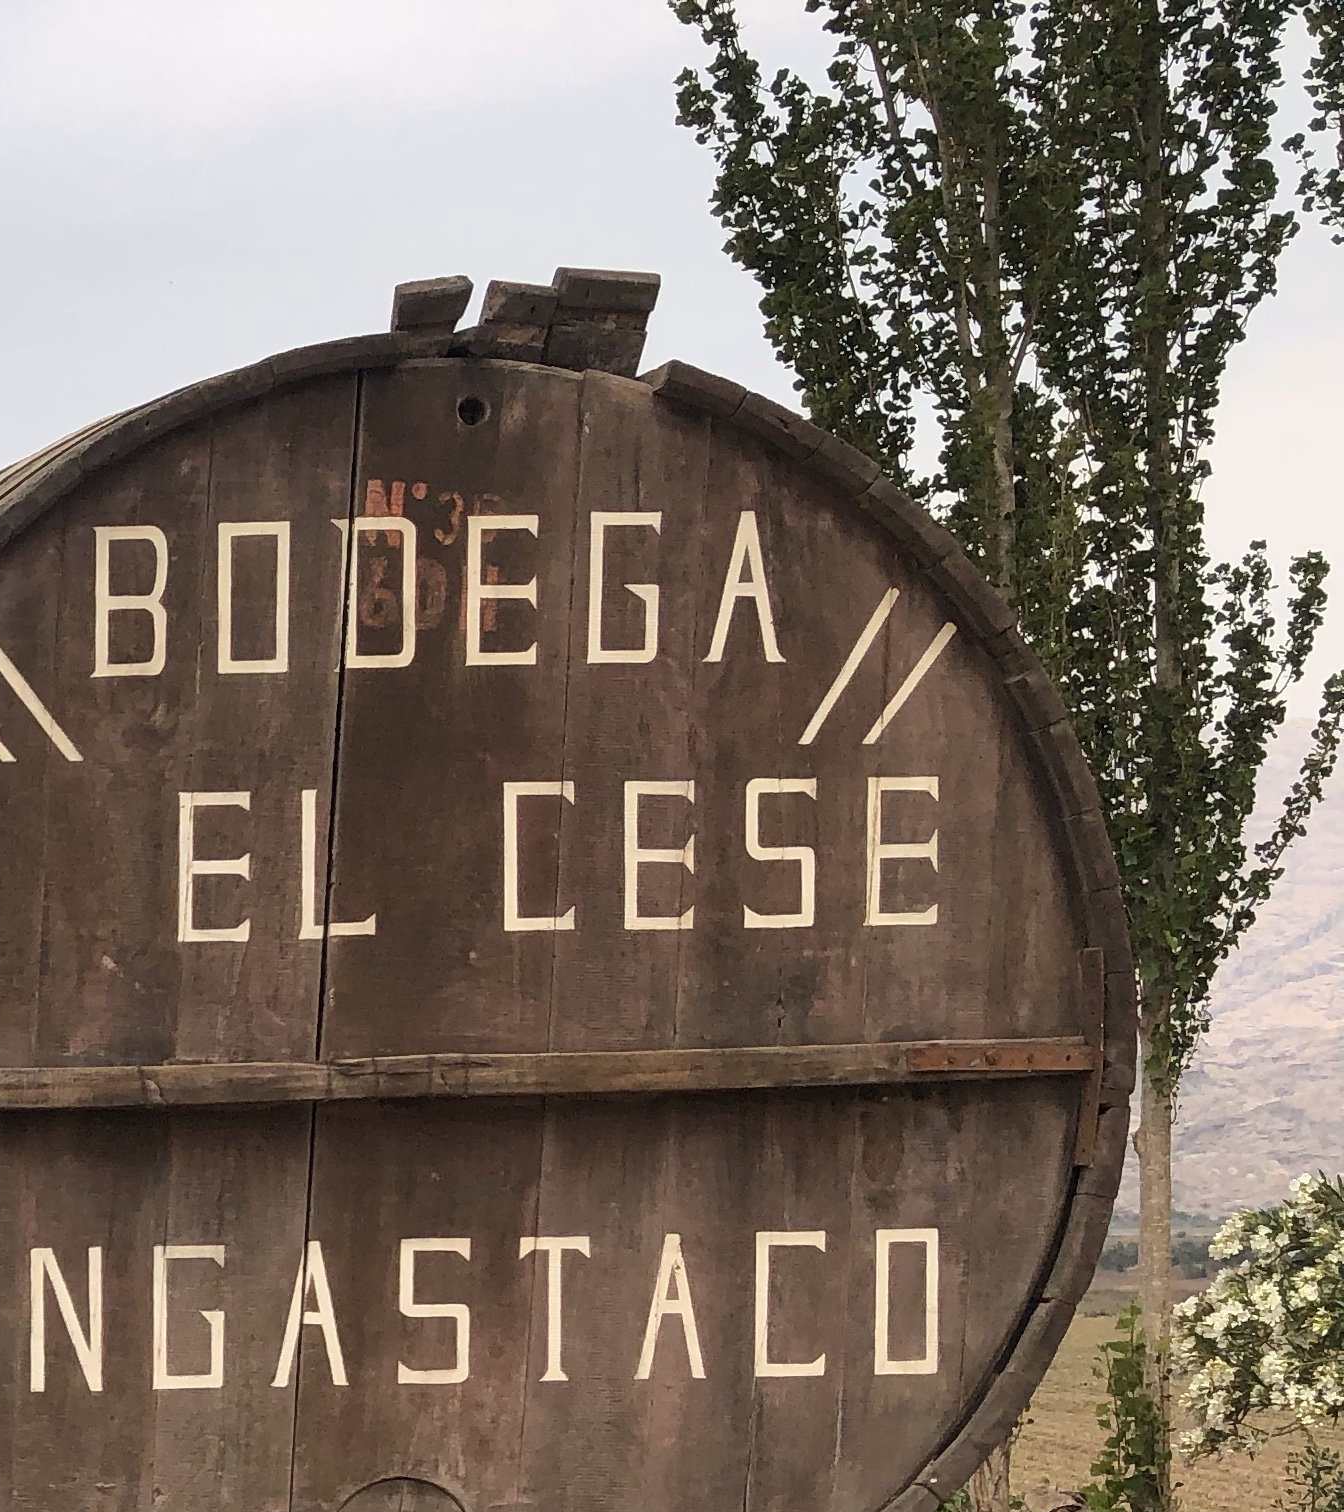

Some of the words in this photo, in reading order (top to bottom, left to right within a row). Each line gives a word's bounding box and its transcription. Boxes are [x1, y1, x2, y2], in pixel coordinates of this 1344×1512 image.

[90, 510, 787, 678] BODEGA
[176, 789, 377, 942] EL
[502, 776, 940, 932] CESE
